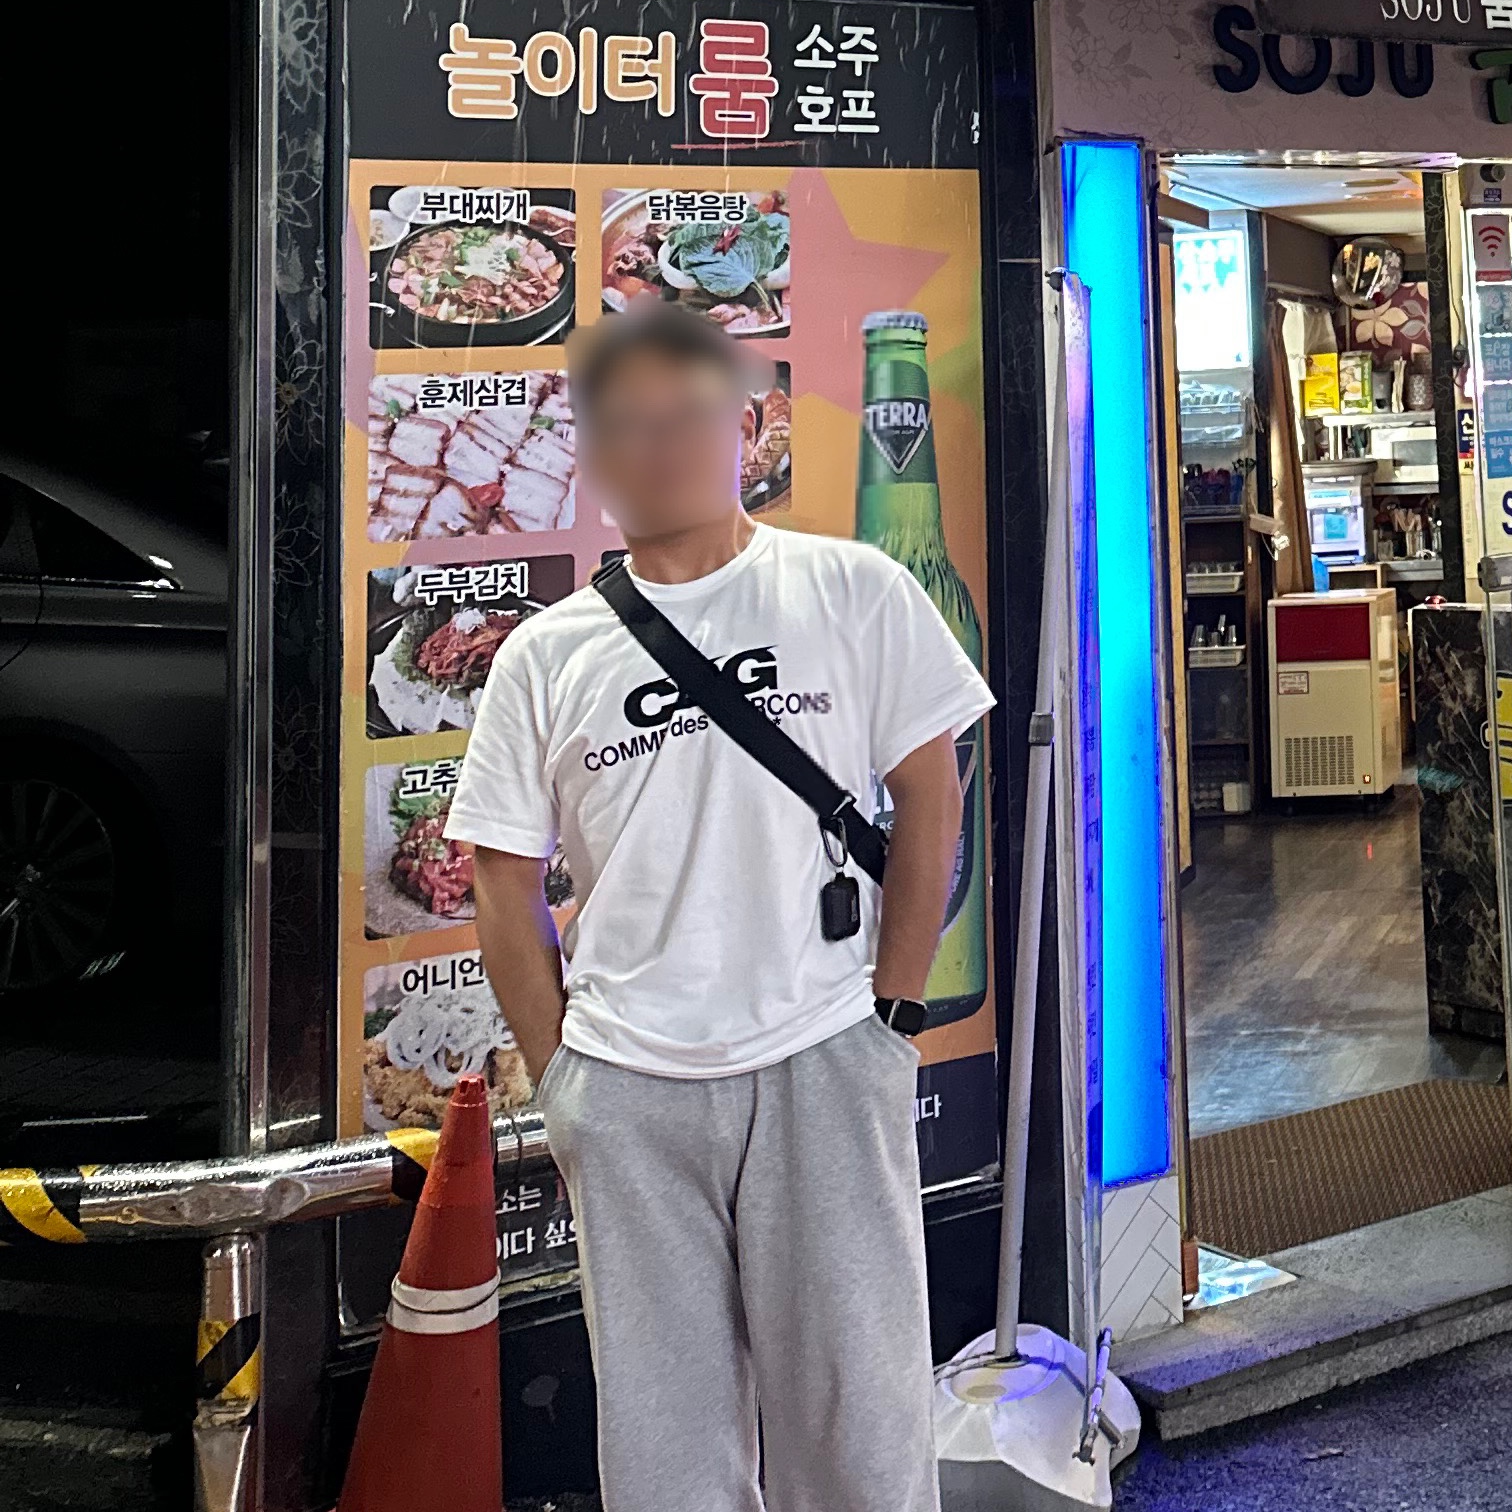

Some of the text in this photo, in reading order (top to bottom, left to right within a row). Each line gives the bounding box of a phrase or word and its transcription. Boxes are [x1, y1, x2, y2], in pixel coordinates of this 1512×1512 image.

[439, 17, 880, 140] 놀이터 룸 소주
[793, 87, 880, 135] 호프
[420, 190, 532, 223] 부대찌개
[648, 192, 749, 223] 닭볶음탕
[419, 375, 529, 410] 훈제삼겹
[865, 401, 930, 431] TERRA
[416, 563, 528, 605] 두부김치
[624, 645, 778, 728] CG
[671, 714, 709, 738] des
[752, 691, 833, 717] RCONS
[400, 762, 463, 798] 고추
[401, 954, 486, 996] 어니언
